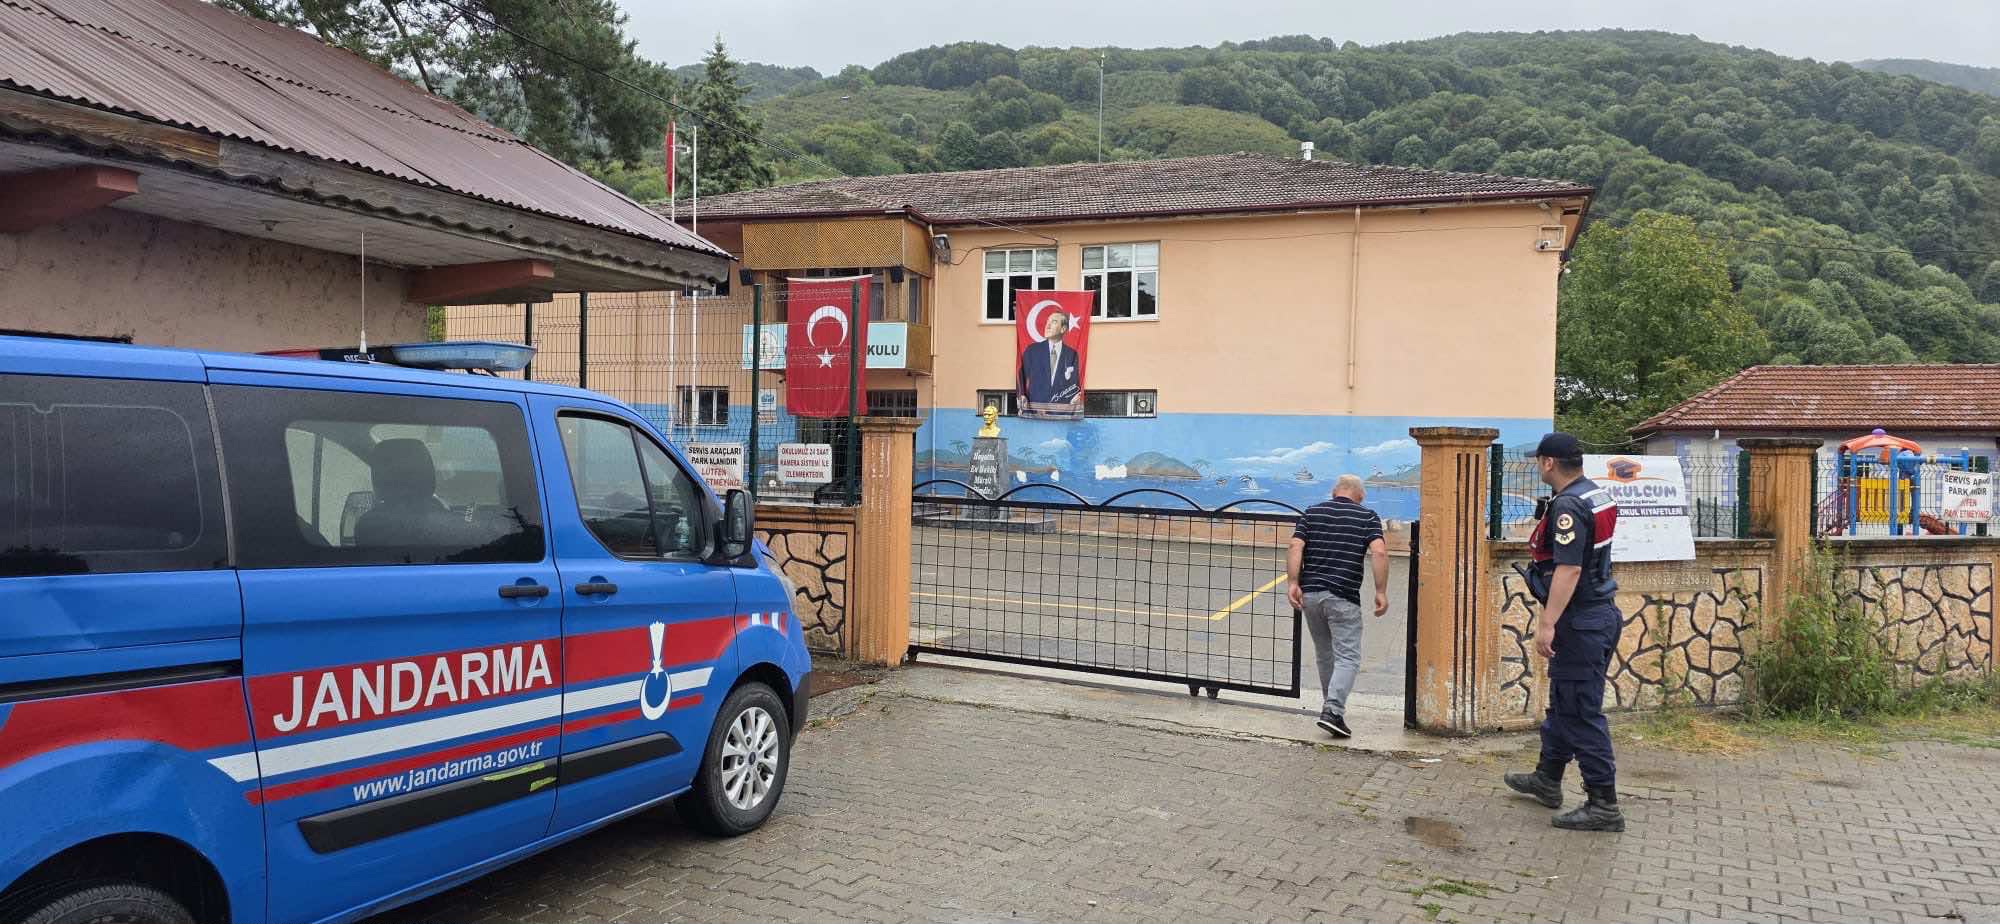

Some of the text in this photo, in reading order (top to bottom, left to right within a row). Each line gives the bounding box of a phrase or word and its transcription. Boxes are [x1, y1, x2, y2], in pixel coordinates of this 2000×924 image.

[710, 447, 741, 456] ARAÇLARI
[691, 456, 708, 464] PARK
[1948, 486, 1968, 496] PARK
[1619, 507, 1640, 516] OKUL
[273, 643, 553, 732] JANDARMA
[352, 740, 543, 801] www.jandarma.gov.tr
